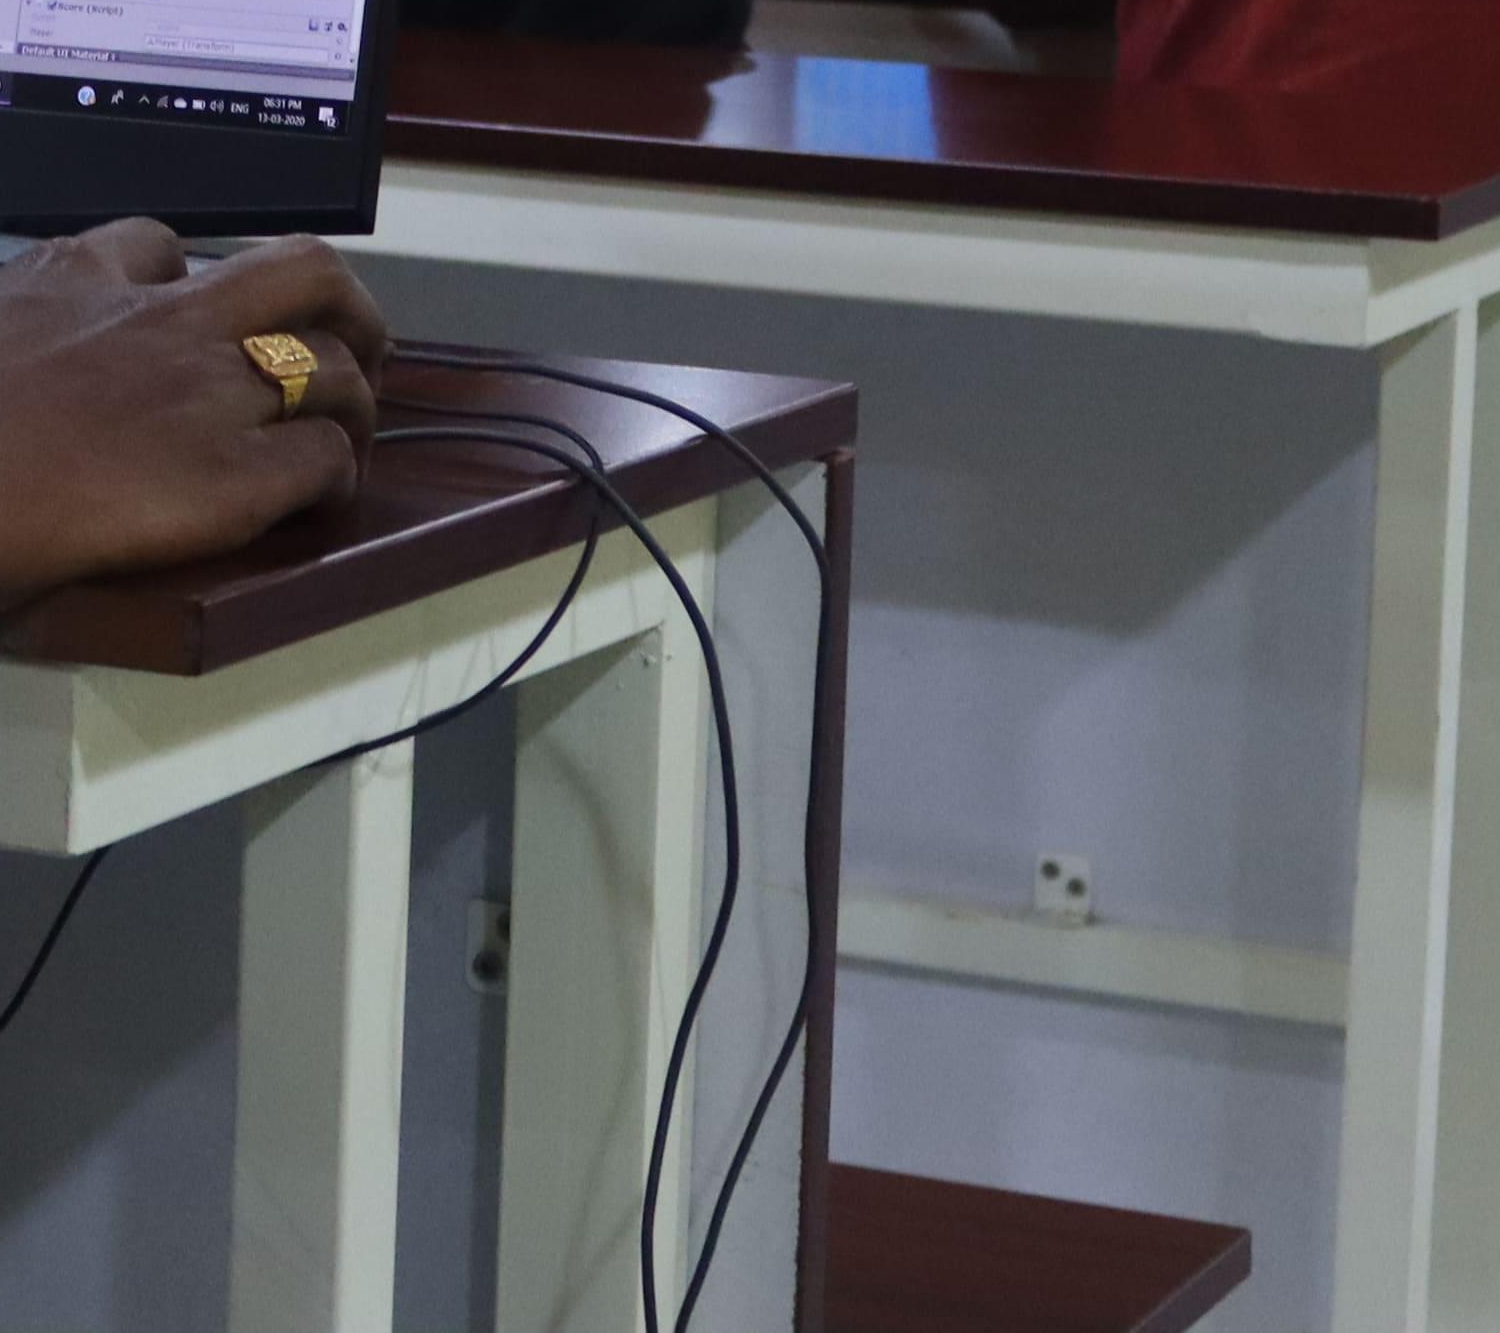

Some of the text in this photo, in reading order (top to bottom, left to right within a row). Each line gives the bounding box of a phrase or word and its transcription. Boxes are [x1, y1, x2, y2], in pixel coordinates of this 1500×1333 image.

[57, 2, 124, 17] Score (Script)
[182, 40, 236, 53] (Transform)
[21, 46, 55, 57] Default
[70, 50, 109, 62] Material
[231, 102, 249, 115] ENG
[287, 99, 302, 110] PM
[258, 112, 306, 127] 13-03-2020
